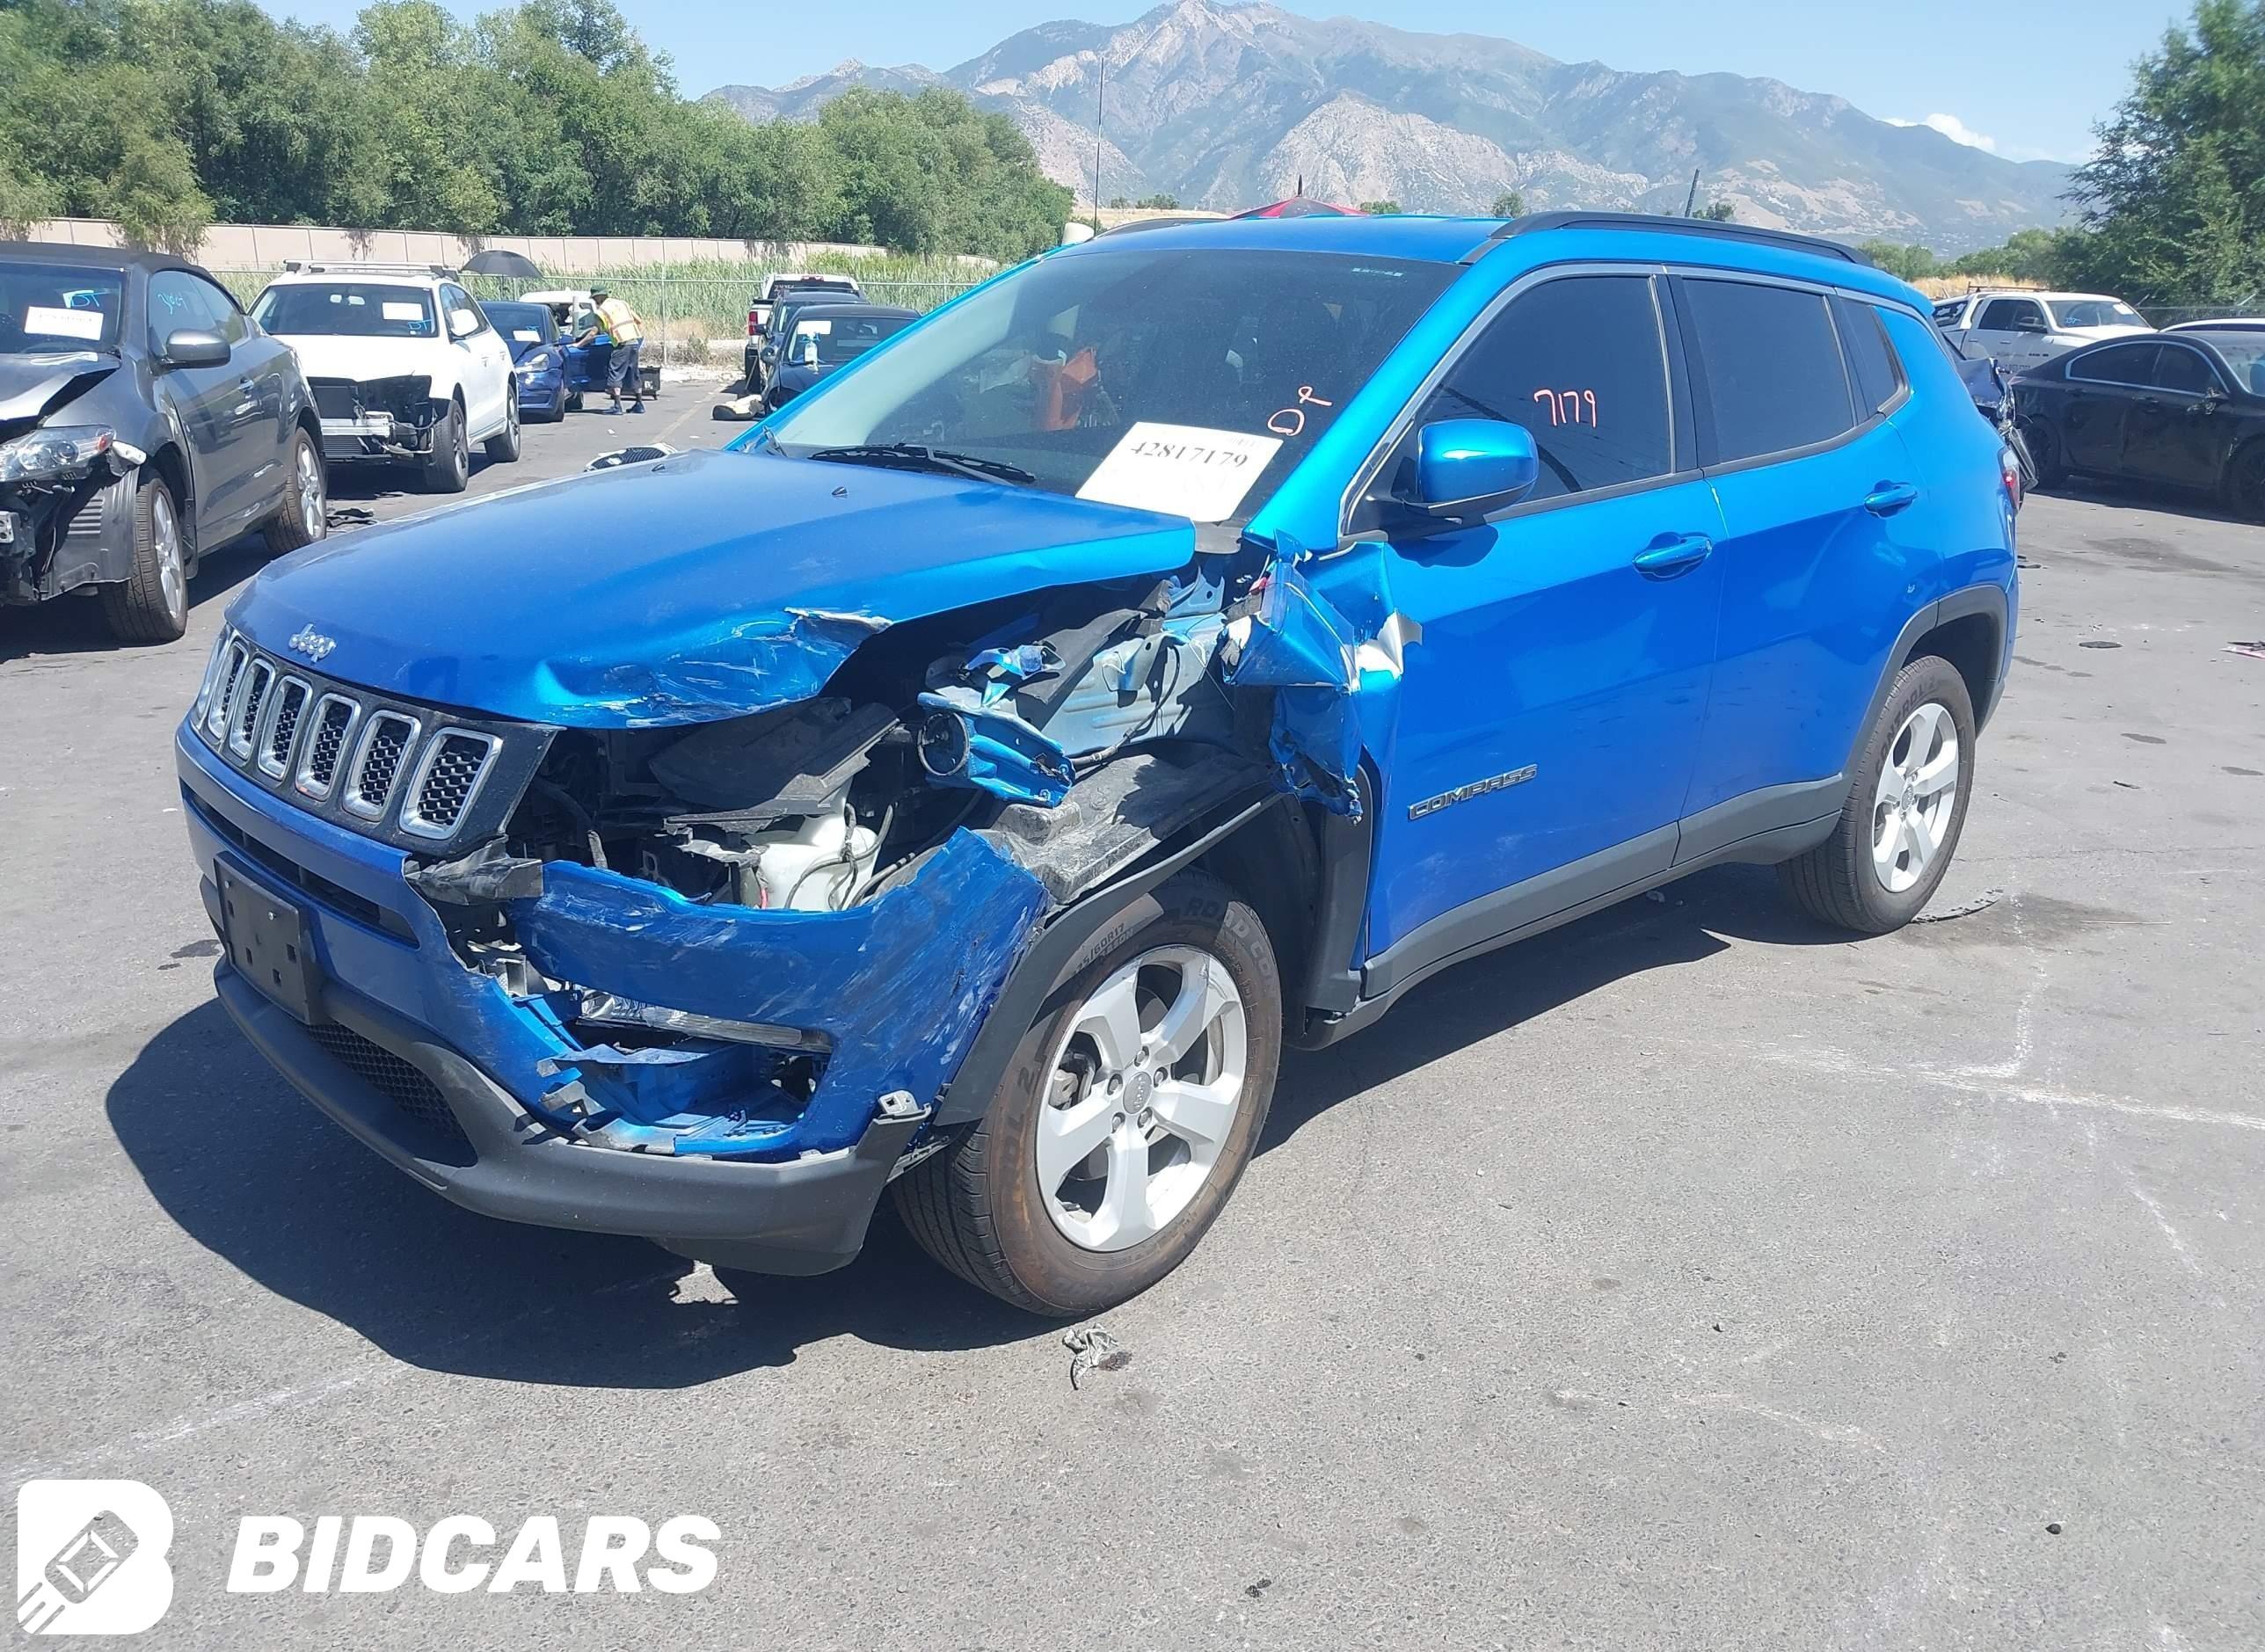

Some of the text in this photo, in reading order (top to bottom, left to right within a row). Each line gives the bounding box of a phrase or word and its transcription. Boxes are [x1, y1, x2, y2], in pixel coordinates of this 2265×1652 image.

[1533, 389, 1597, 428] 7179
[1131, 440, 1249, 468] 42817179
[1409, 763, 1539, 820] COMPASS
